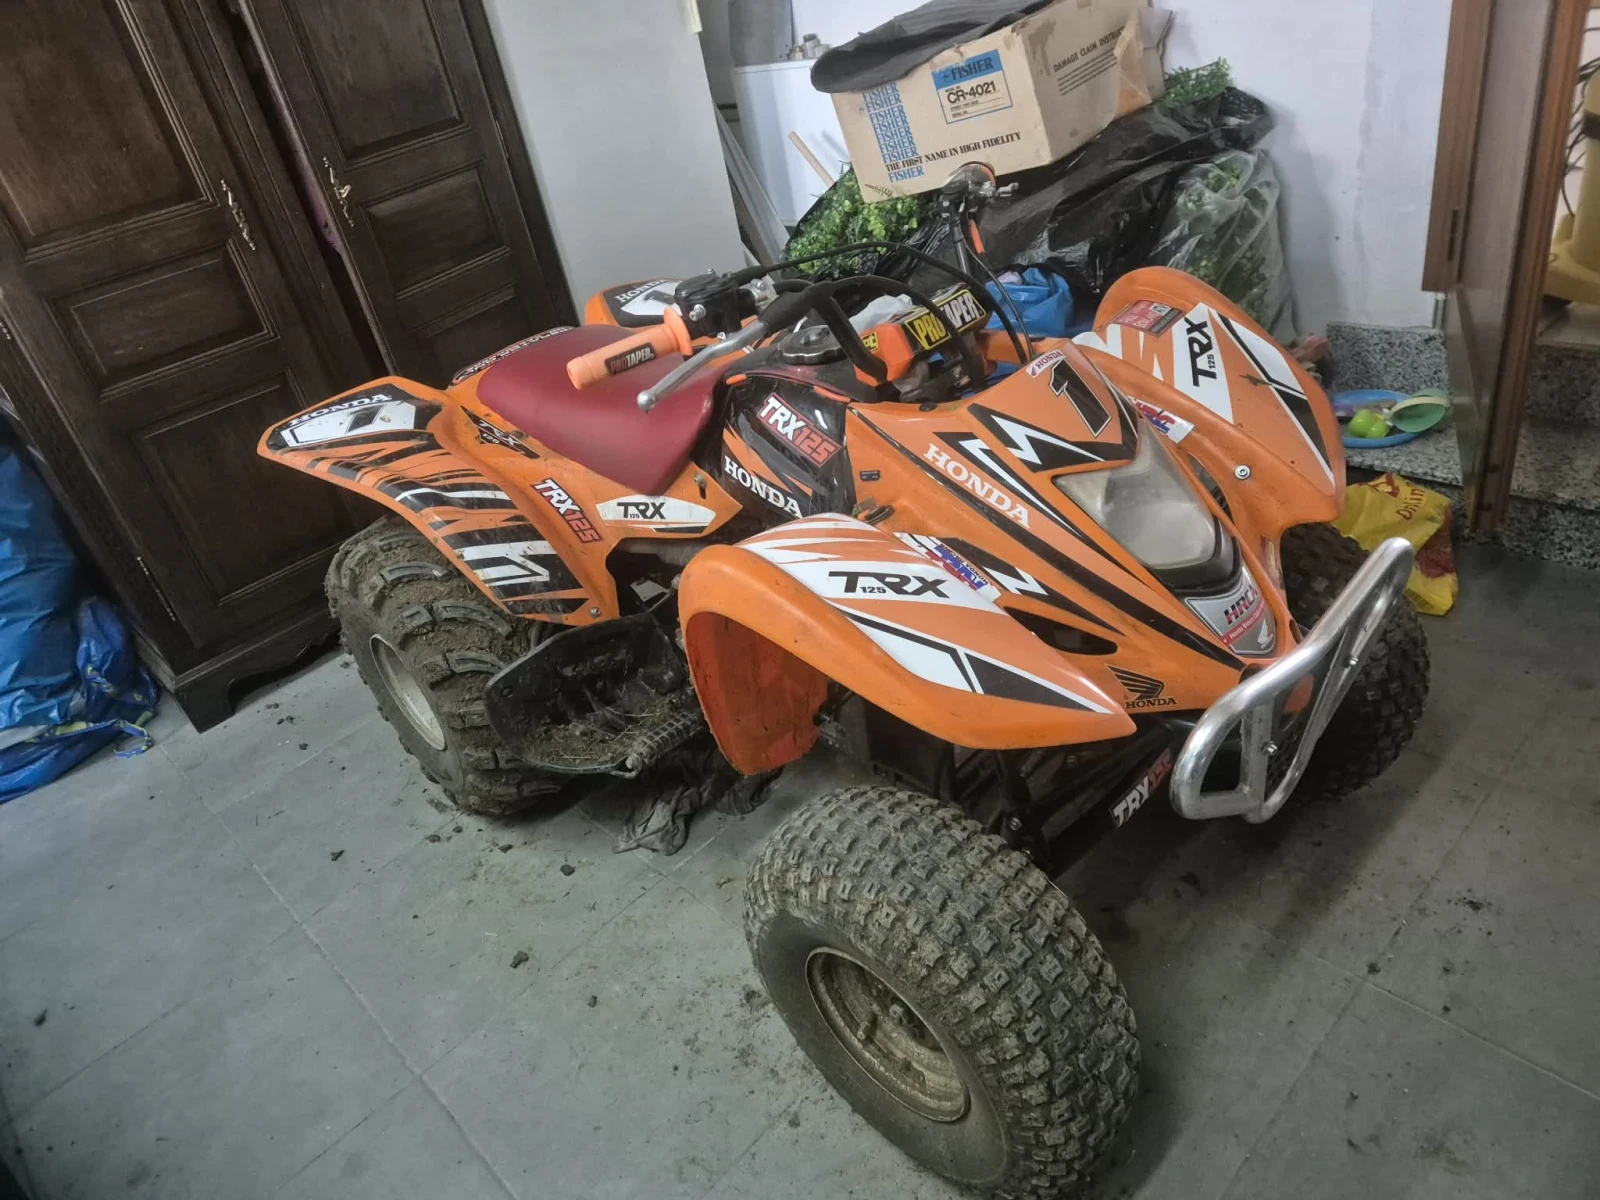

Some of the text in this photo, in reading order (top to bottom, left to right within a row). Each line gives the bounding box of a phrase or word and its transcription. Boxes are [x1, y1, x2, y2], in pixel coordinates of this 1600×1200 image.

[1053, 52, 1079, 72] DAMAGE
[1080, 41, 1098, 57] CLAIM
[950, 57, 994, 80] FISHER
[863, 82, 899, 102] FISHER
[947, 80, 996, 104] CR-4021
[865, 92, 902, 113] FISHER
[869, 104, 906, 124] FISHER
[872, 115, 909, 135] FISHER
[876, 125, 912, 145] FISHER
[879, 135, 916, 155] FISHER
[882, 146, 919, 164] FISHER
[885, 131, 1021, 172] THE FIRST NAME IN HIGH FIDELITY
[888, 166, 925, 183] FISHER
[1036, 350, 1063, 370] HONDA
[1183, 317, 1217, 387] TRX
[1207, 354, 1216, 369] 125
[290, 394, 393, 427] HONDA
[760, 396, 837, 463] TRX125
[724, 455, 803, 519] HONDA
[923, 443, 1031, 529] HONDA
[531, 477, 602, 543] TRX125
[617, 502, 666, 520] TRX
[828, 571, 950, 599] TRX
[859, 586, 887, 595] 125
[1125, 697, 1177, 709] HONDA
